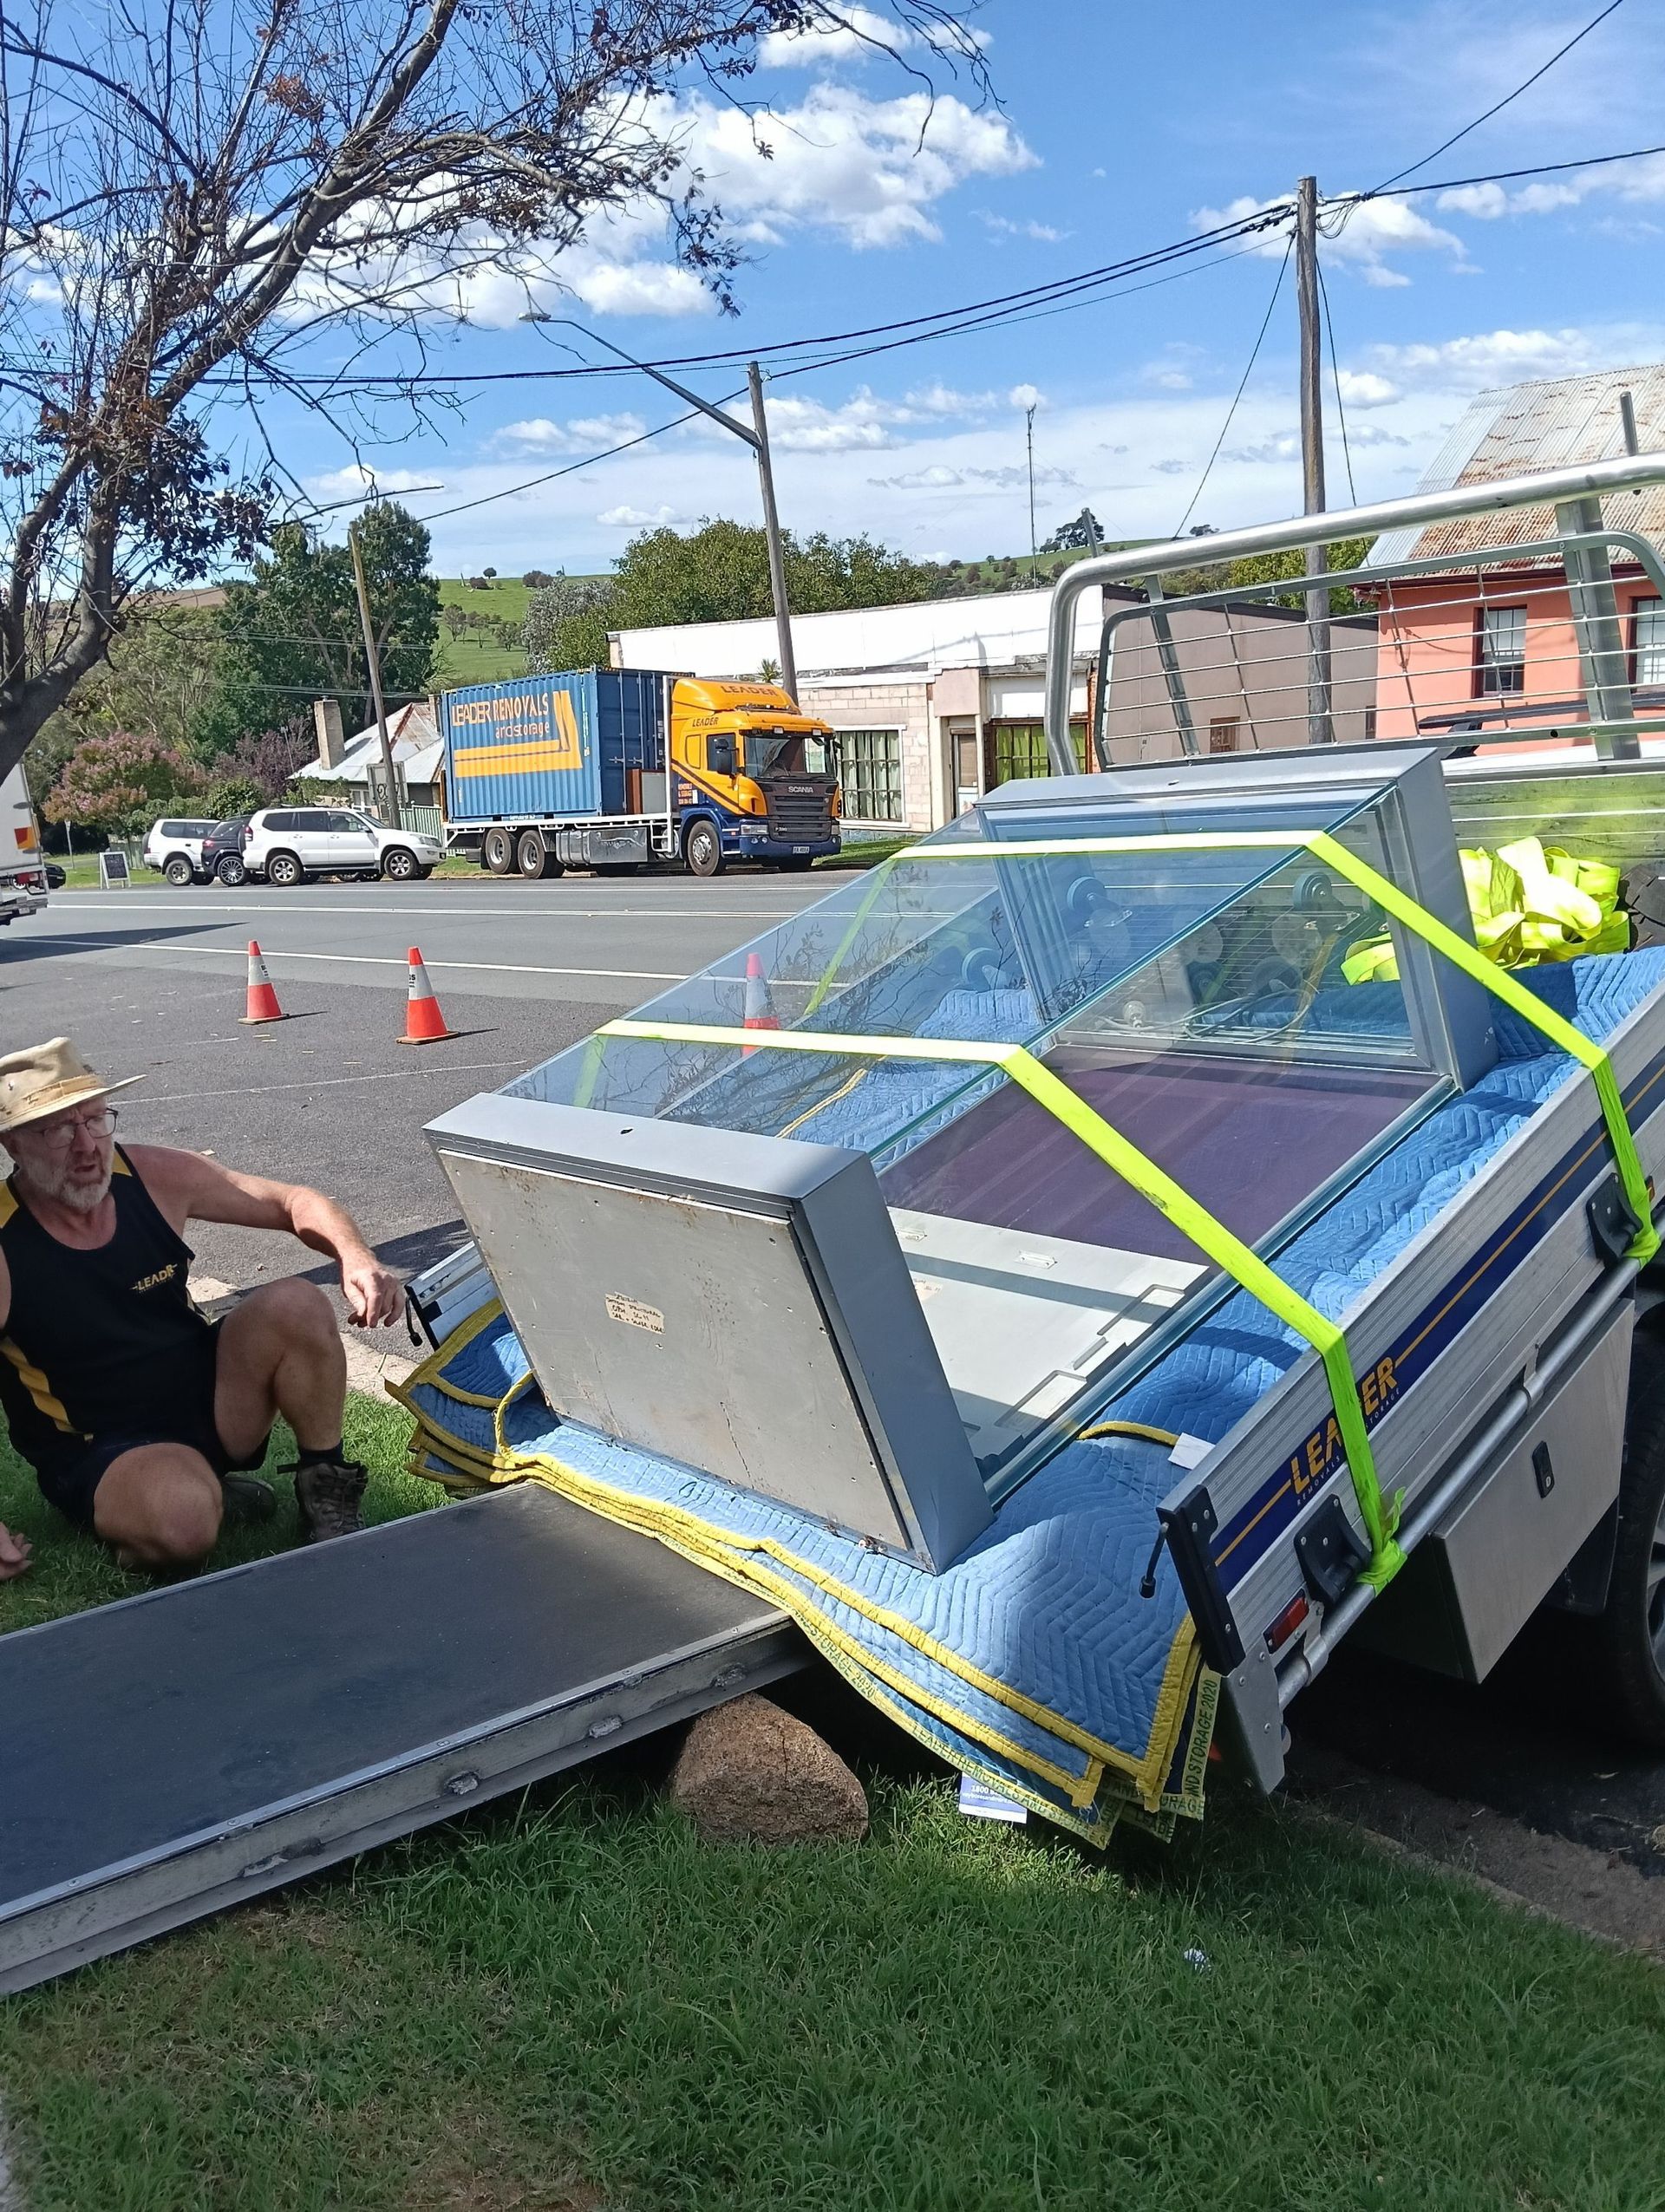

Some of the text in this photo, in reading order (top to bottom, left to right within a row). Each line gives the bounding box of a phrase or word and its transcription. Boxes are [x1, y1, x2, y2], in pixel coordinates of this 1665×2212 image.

[721, 686, 778, 696] LEADER
[452, 701, 492, 726] LEADER
[692, 717, 719, 728] LEADER
[1291, 1356, 1398, 1495] LEAER
[1297, 1455, 1341, 1506] REMOVALS
[1188, 1710, 1212, 1774] STORAGE
[1202, 1679, 1218, 1709] 2020
